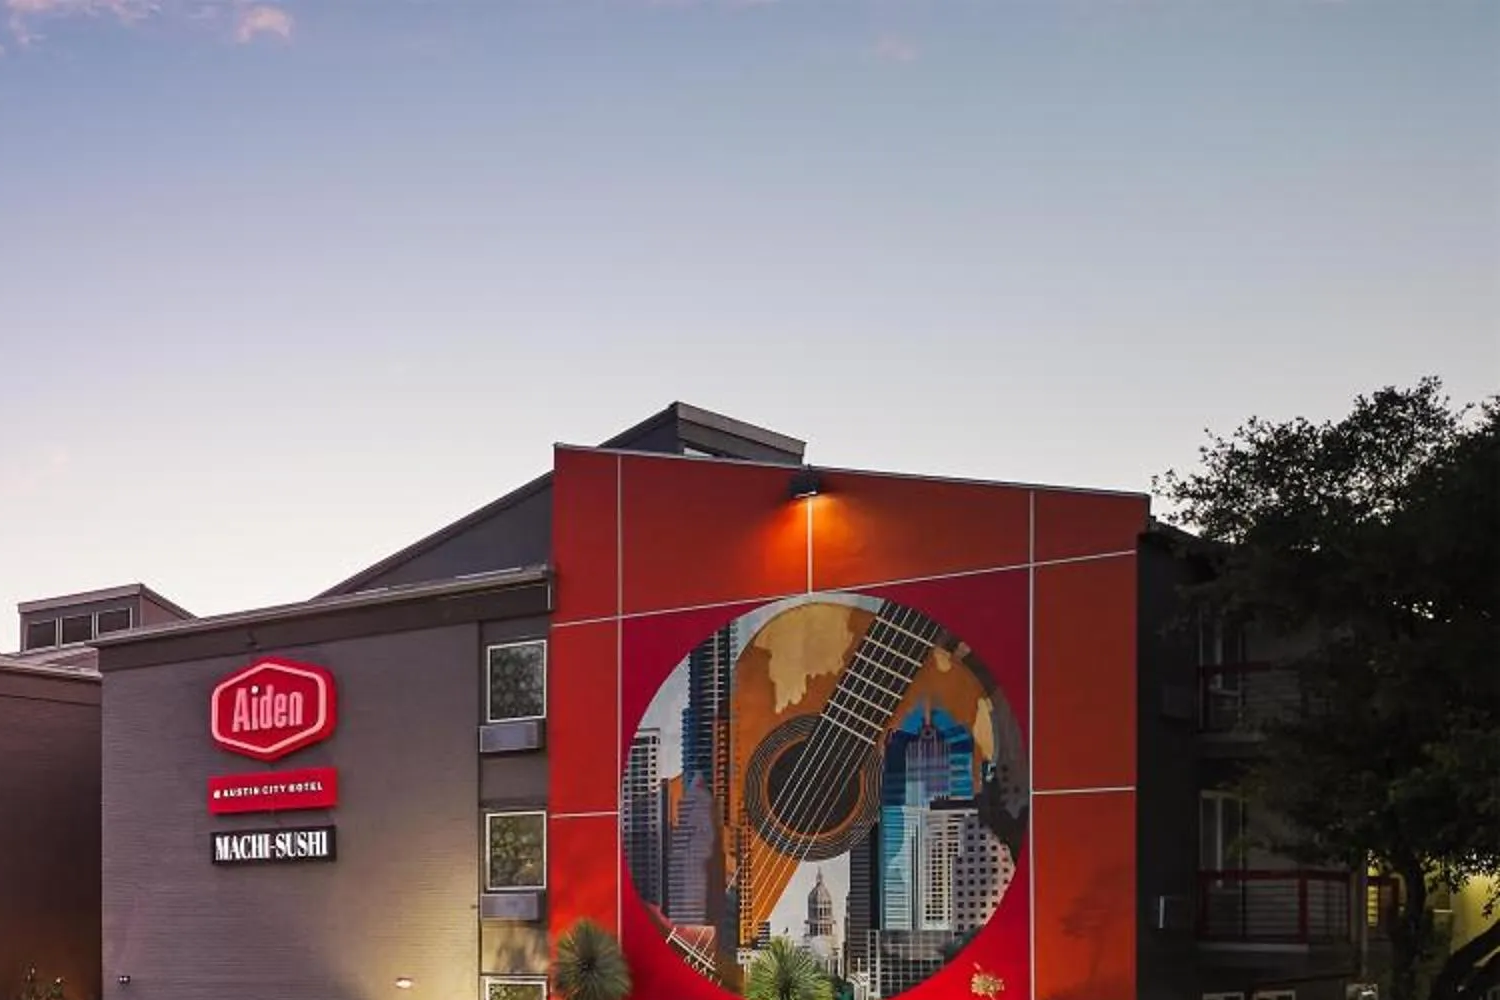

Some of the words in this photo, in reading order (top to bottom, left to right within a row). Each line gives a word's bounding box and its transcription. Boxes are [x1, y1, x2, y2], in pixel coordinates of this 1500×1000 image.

[232, 685, 304, 732] Aiden
[223, 787, 260, 798] AUSTIN
[261, 784, 286, 795] CITY
[288, 781, 323, 793] HOTEL
[215, 831, 329, 861] MACHI-SUSHI
